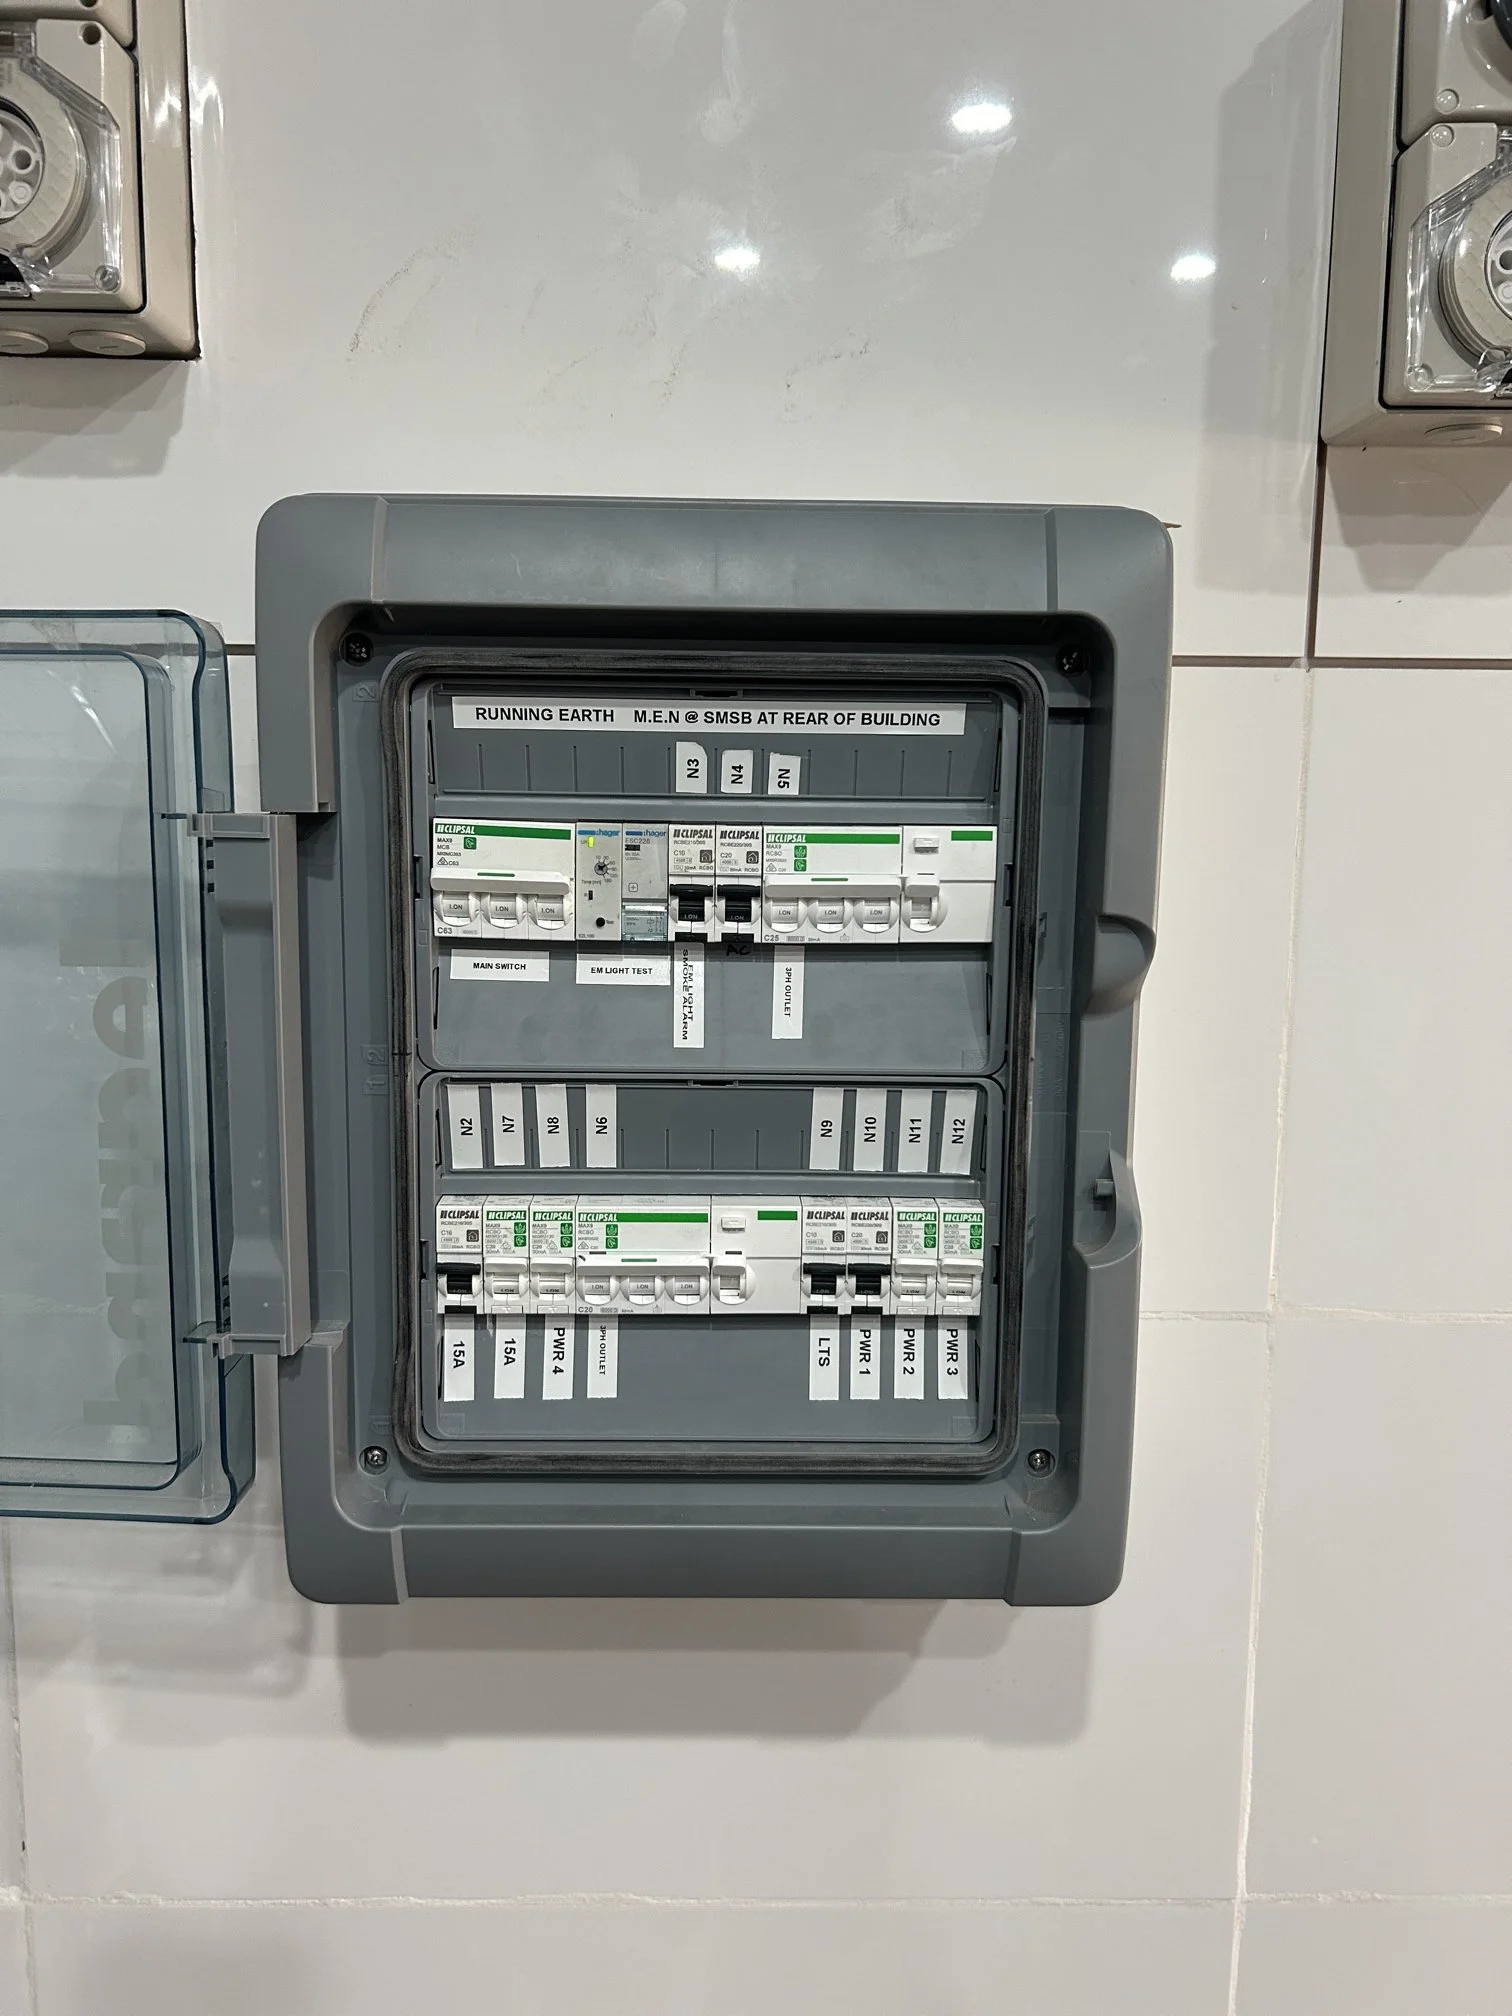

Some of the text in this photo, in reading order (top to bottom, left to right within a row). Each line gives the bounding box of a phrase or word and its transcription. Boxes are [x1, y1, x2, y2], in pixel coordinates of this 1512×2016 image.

[475, 707, 941, 727] RUNNING EARTH M.E.N @ SMSB AT REAR OF BUILDING
[687, 758, 699, 779] N3
[731, 764, 744, 785] N4
[777, 768, 790, 789] N5
[444, 824, 476, 834] CLIPSAL
[681, 829, 713, 839] CLIPSAL
[727, 830, 760, 840] CLIPSAL
[774, 834, 807, 843] CLIPSAL
[473, 962, 527, 971] MAIN SWITCH
[591, 967, 653, 976] EM LIGHT TEST
[784, 967, 792, 1017] 3PH OUTLET
[460, 1118, 473, 1136] N2
[503, 1115, 515, 1133] N7
[547, 1116, 560, 1134] N8
[595, 1116, 608, 1135] N6
[820, 1120, 833, 1138] N9
[864, 1116, 877, 1143] N10
[909, 1118, 922, 1143] N11
[952, 1118, 966, 1144] N12
[448, 1210, 480, 1219] CLIPSAL
[494, 1211, 526, 1220] CLIPSAL
[541, 1212, 572, 1221] CLIPSAL
[586, 1213, 618, 1222] CLIPSAL
[814, 1211, 845, 1220] CLIPSAL
[858, 1212, 889, 1221] CLIPSAL
[905, 1212, 936, 1221] CLIPSAL
[951, 1213, 982, 1222] CLIPSAL
[599, 1325, 607, 1341] 3PH
[453, 1341, 466, 1369] 15A
[504, 1338, 516, 1366] 15A
[552, 1327, 565, 1375] PWR 4
[818, 1337, 831, 1367] LTS
[859, 1329, 872, 1363] PWR
[903, 1328, 916, 1375] PWR 2
[946, 1328, 959, 1376] PWR 3
